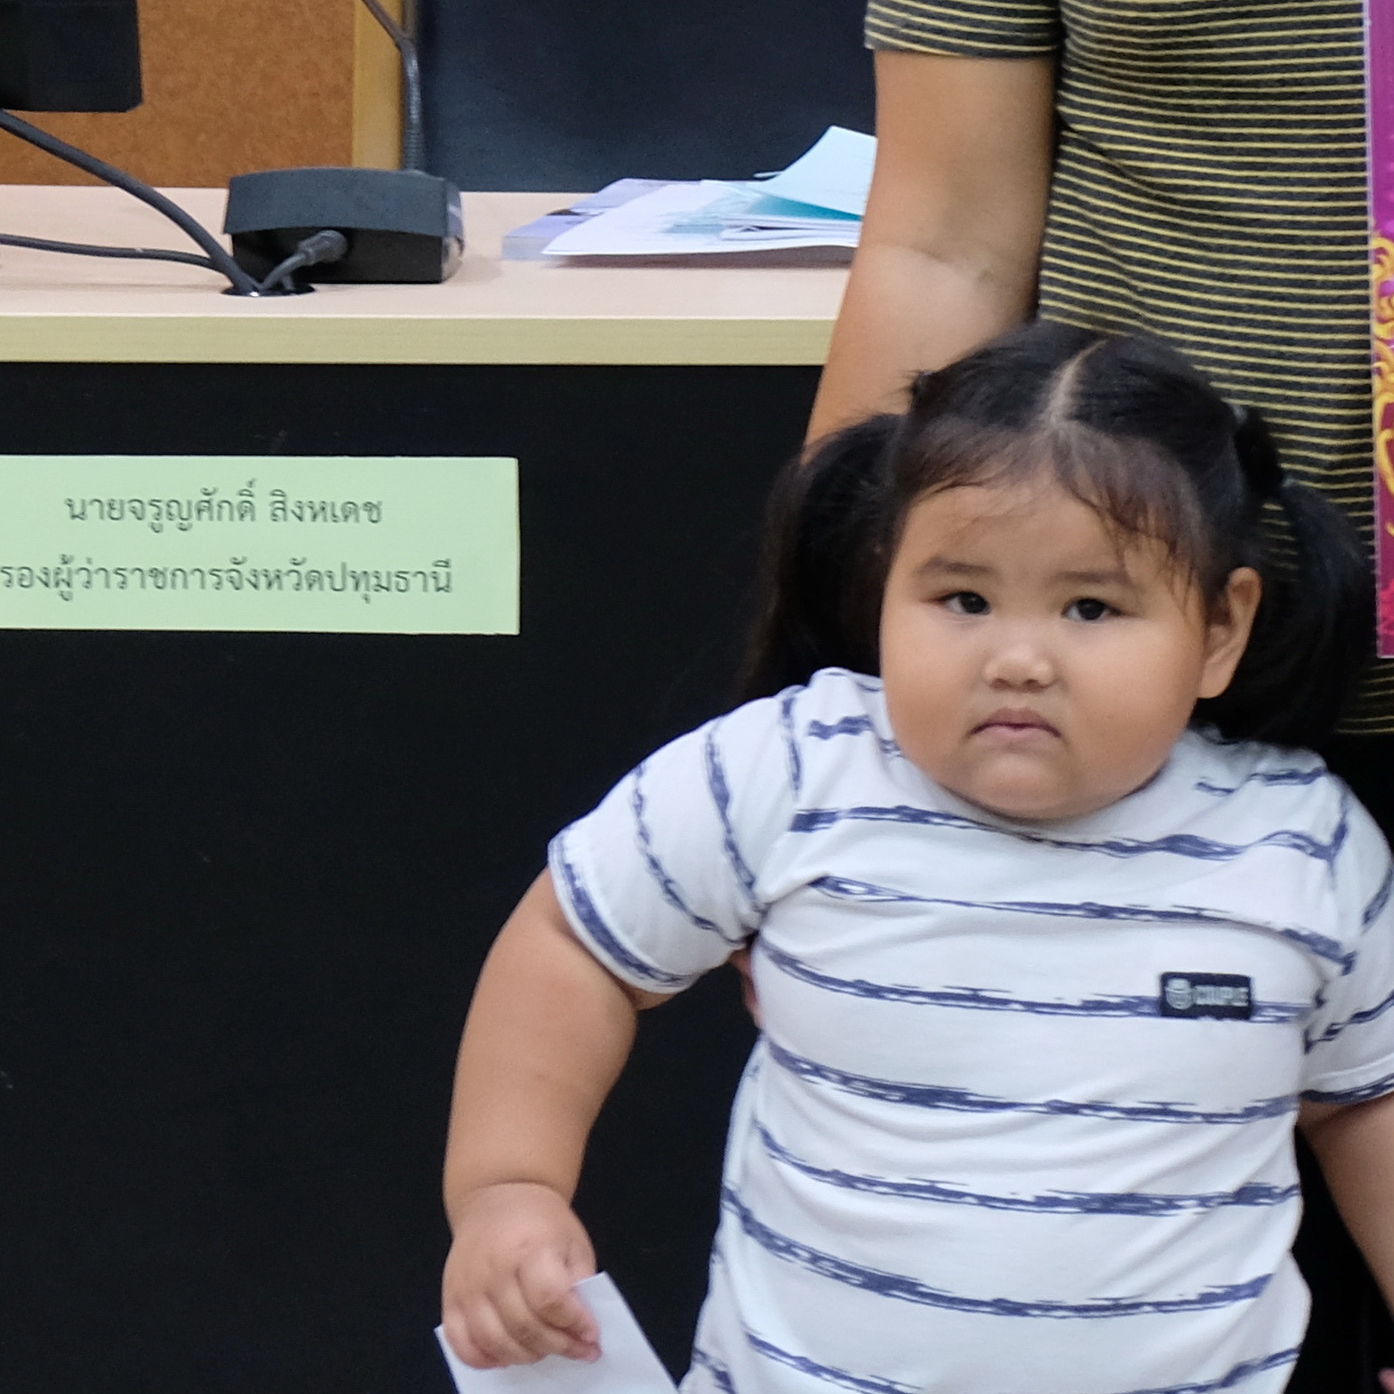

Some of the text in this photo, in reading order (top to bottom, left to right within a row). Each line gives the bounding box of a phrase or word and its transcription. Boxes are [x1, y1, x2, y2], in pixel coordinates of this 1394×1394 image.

[64, 478, 383, 534] นายจรูญศักดิ์ สิงหเดช
[0, 553, 453, 604] รองผู้ว่าราชการจังหวัดปทุมธานี
